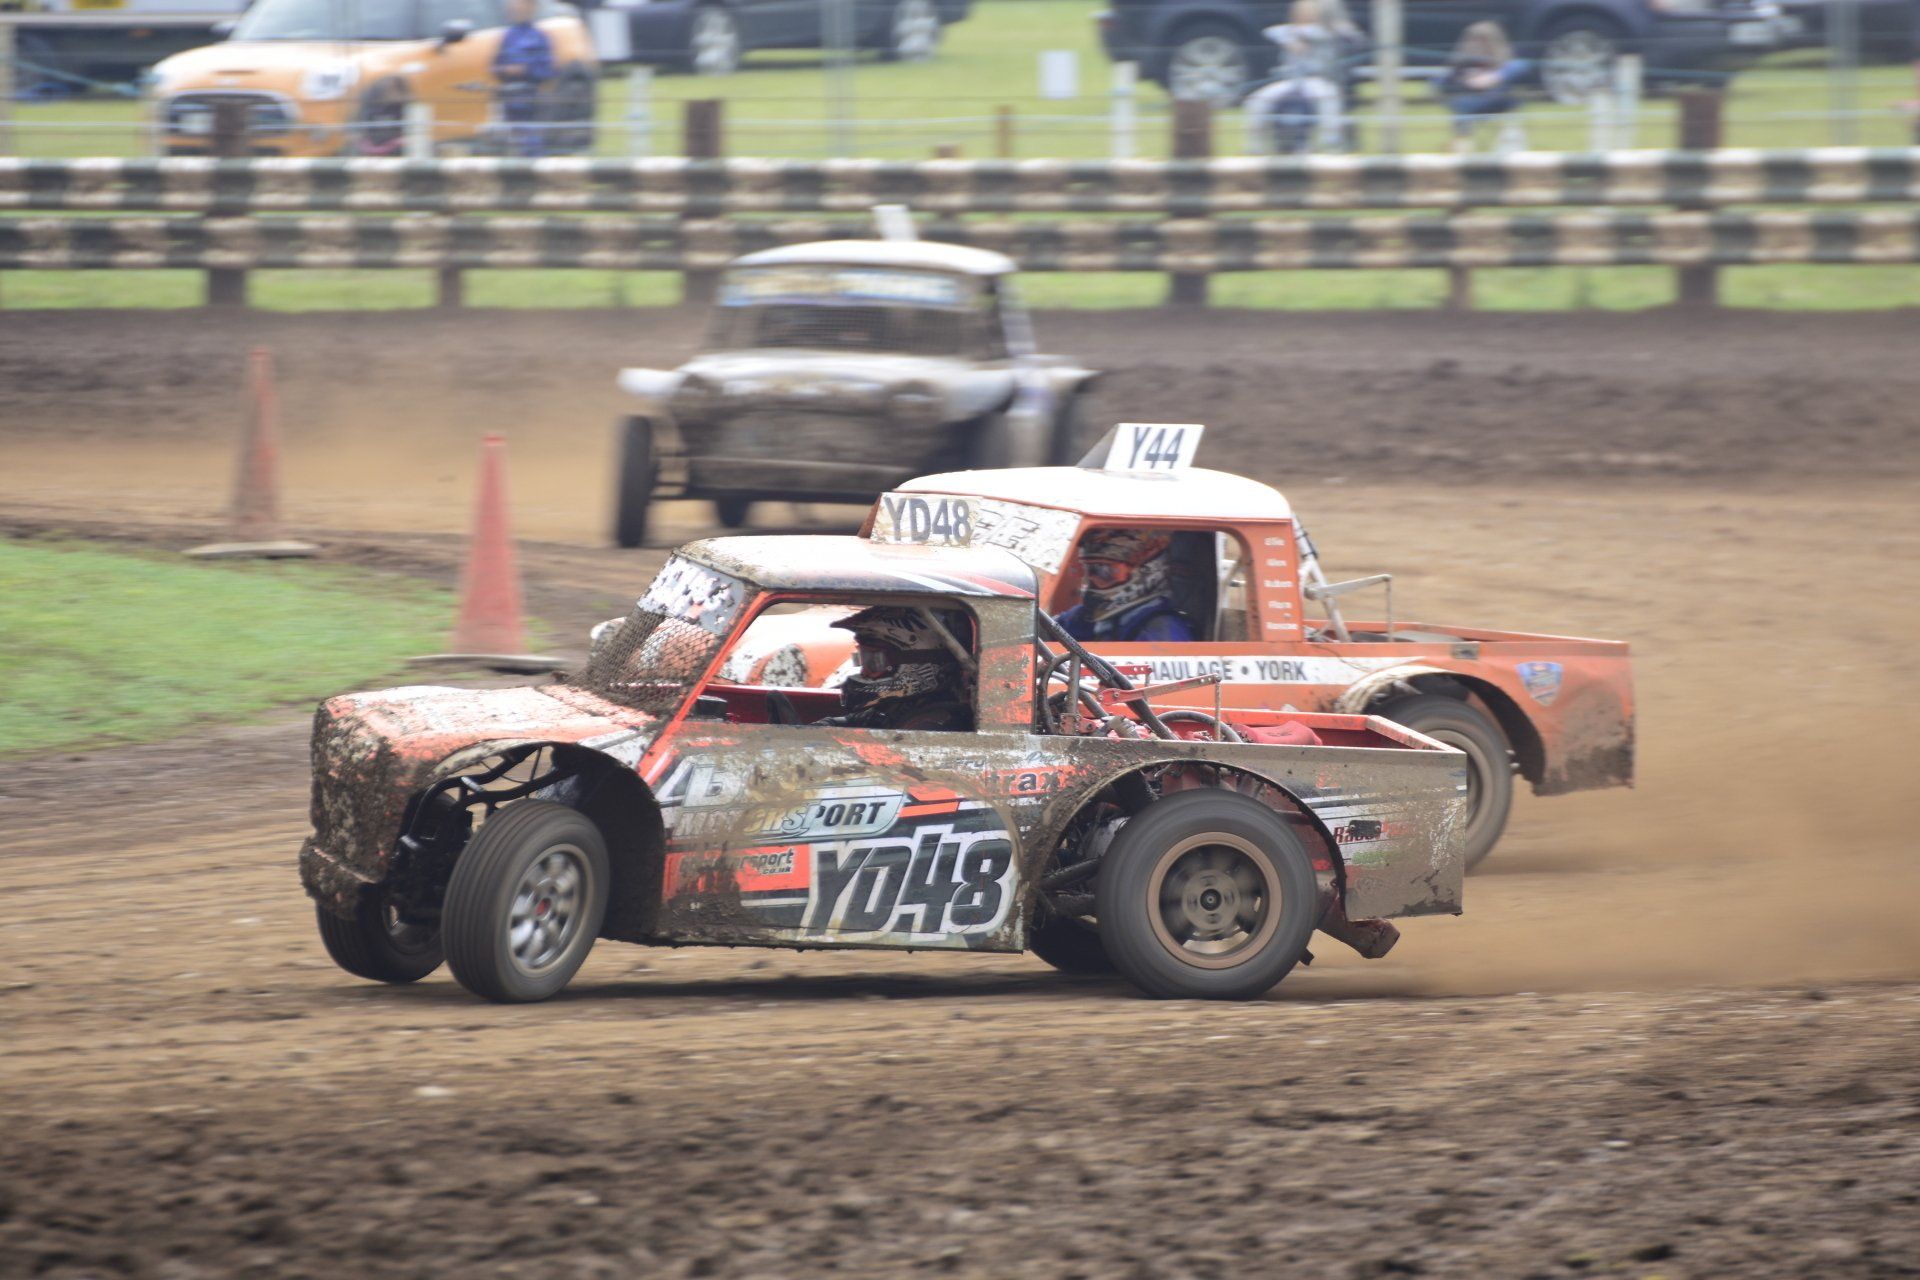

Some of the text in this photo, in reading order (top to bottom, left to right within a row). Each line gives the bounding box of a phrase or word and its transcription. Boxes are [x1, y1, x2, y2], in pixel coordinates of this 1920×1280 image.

[1128, 426, 1186, 469] Y44
[884, 496, 972, 545] YD48
[1256, 660, 1308, 681] YORK
[804, 828, 1015, 937] YD48
